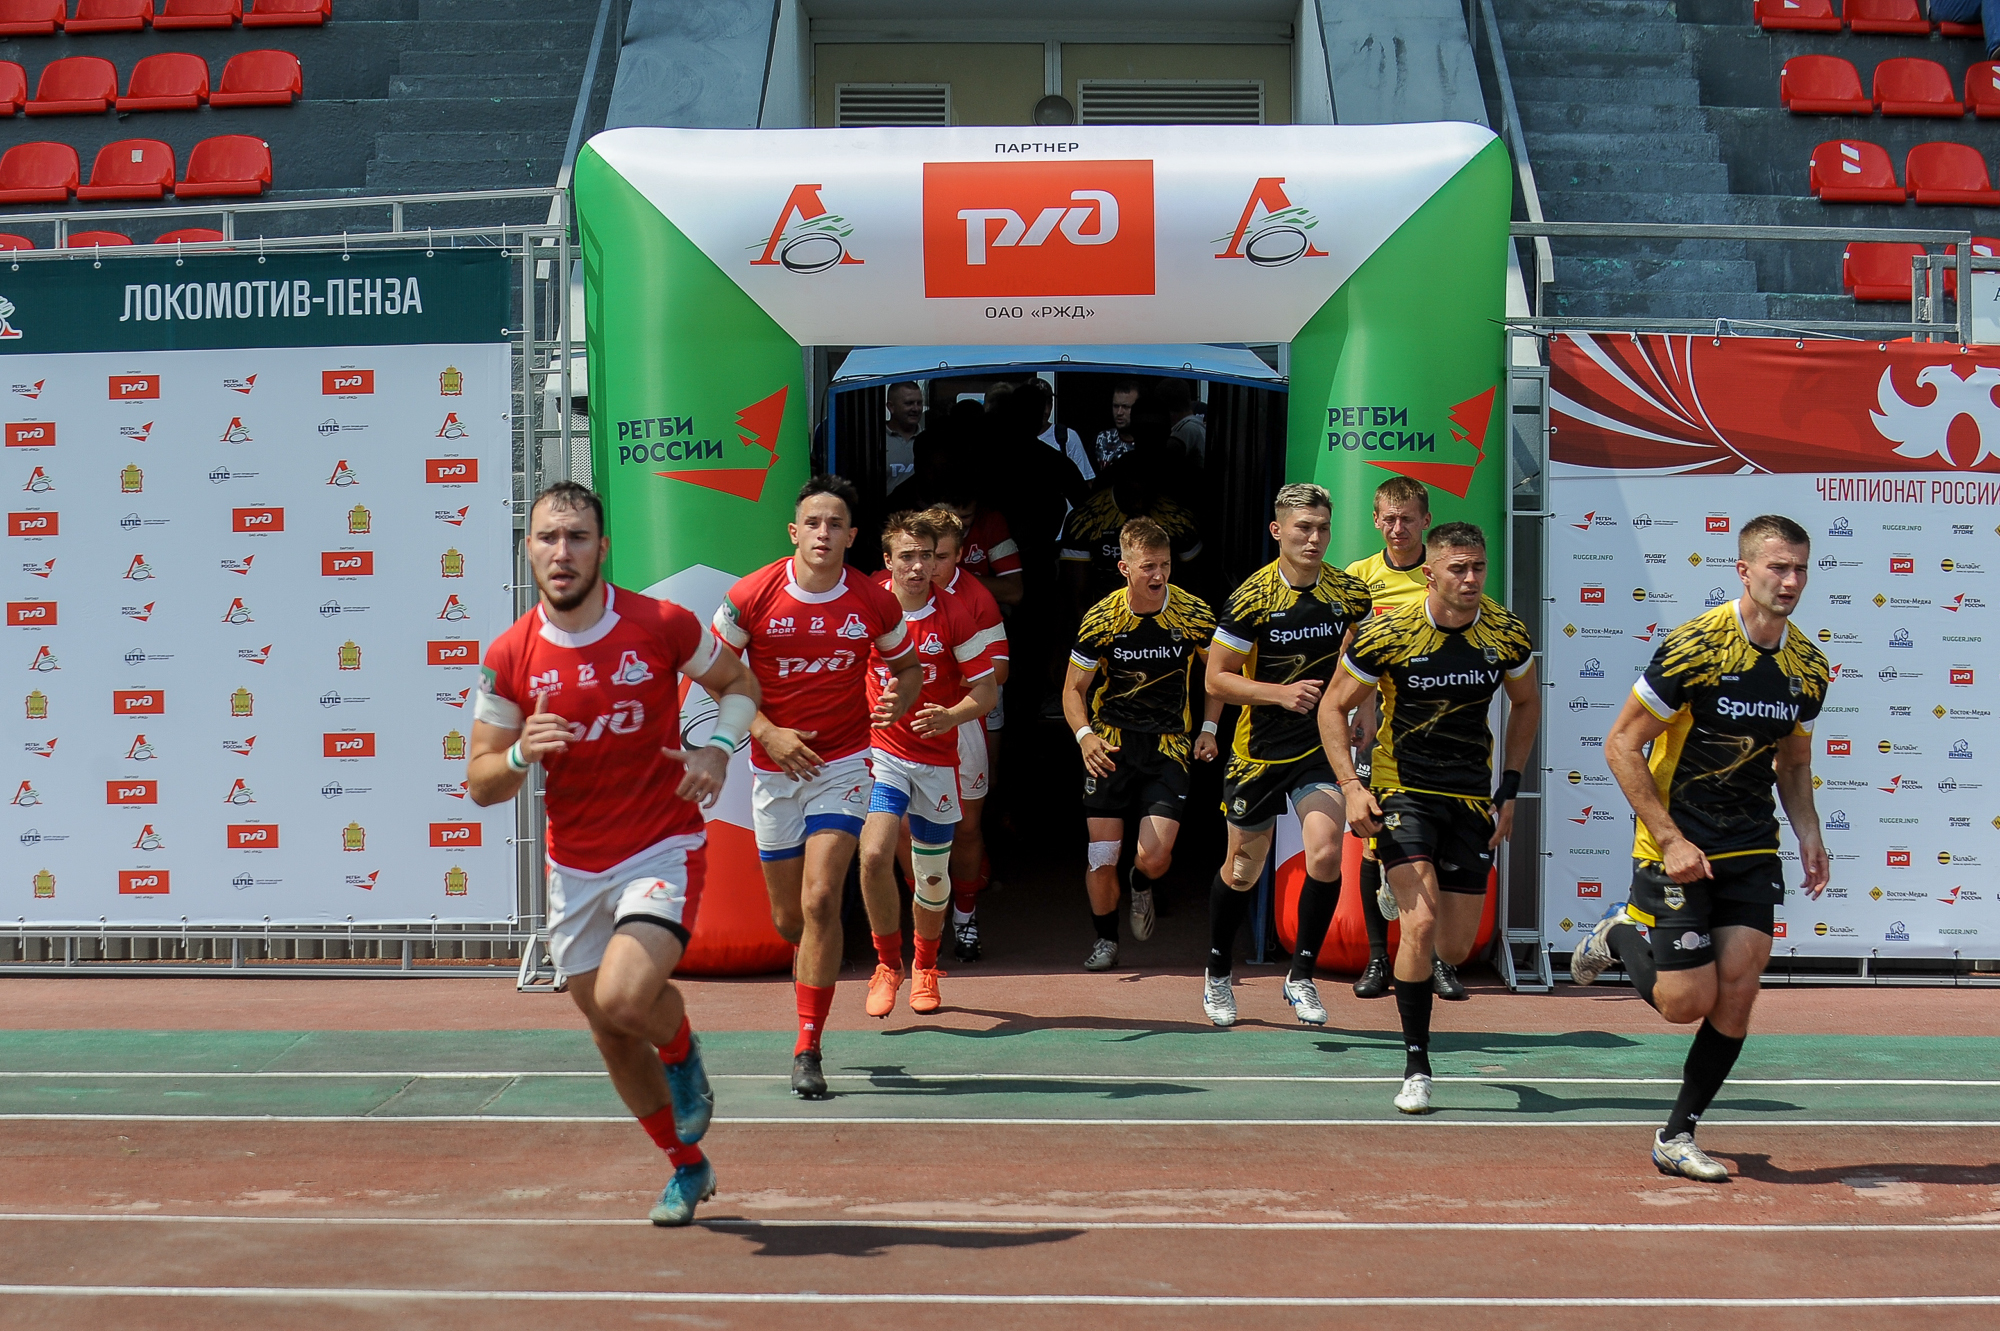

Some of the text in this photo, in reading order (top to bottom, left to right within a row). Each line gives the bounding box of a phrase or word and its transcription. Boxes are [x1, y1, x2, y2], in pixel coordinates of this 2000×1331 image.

[995, 142, 1080, 154] ПАРТНЕР
[119, 276, 423, 322] ЛОКОМОТИВ-ПЕНЗА
[985, 305, 1095, 319] ОАО «РЖД»
[1327, 406, 1408, 428] РЕГБИ
[617, 416, 694, 441] РЕГБИ
[618, 439, 723, 465] РОССИИ
[1327, 431, 1435, 452] РОССИИ
[1816, 478, 2000, 506] ЧЕМПИОНАТ РОССИИ
[1270, 622, 1344, 644] Sputnik V
[1114, 646, 1182, 662] Sputnik V
[1408, 670, 1499, 690] Sputnik V
[1716, 696, 1799, 721] Sputnik V
